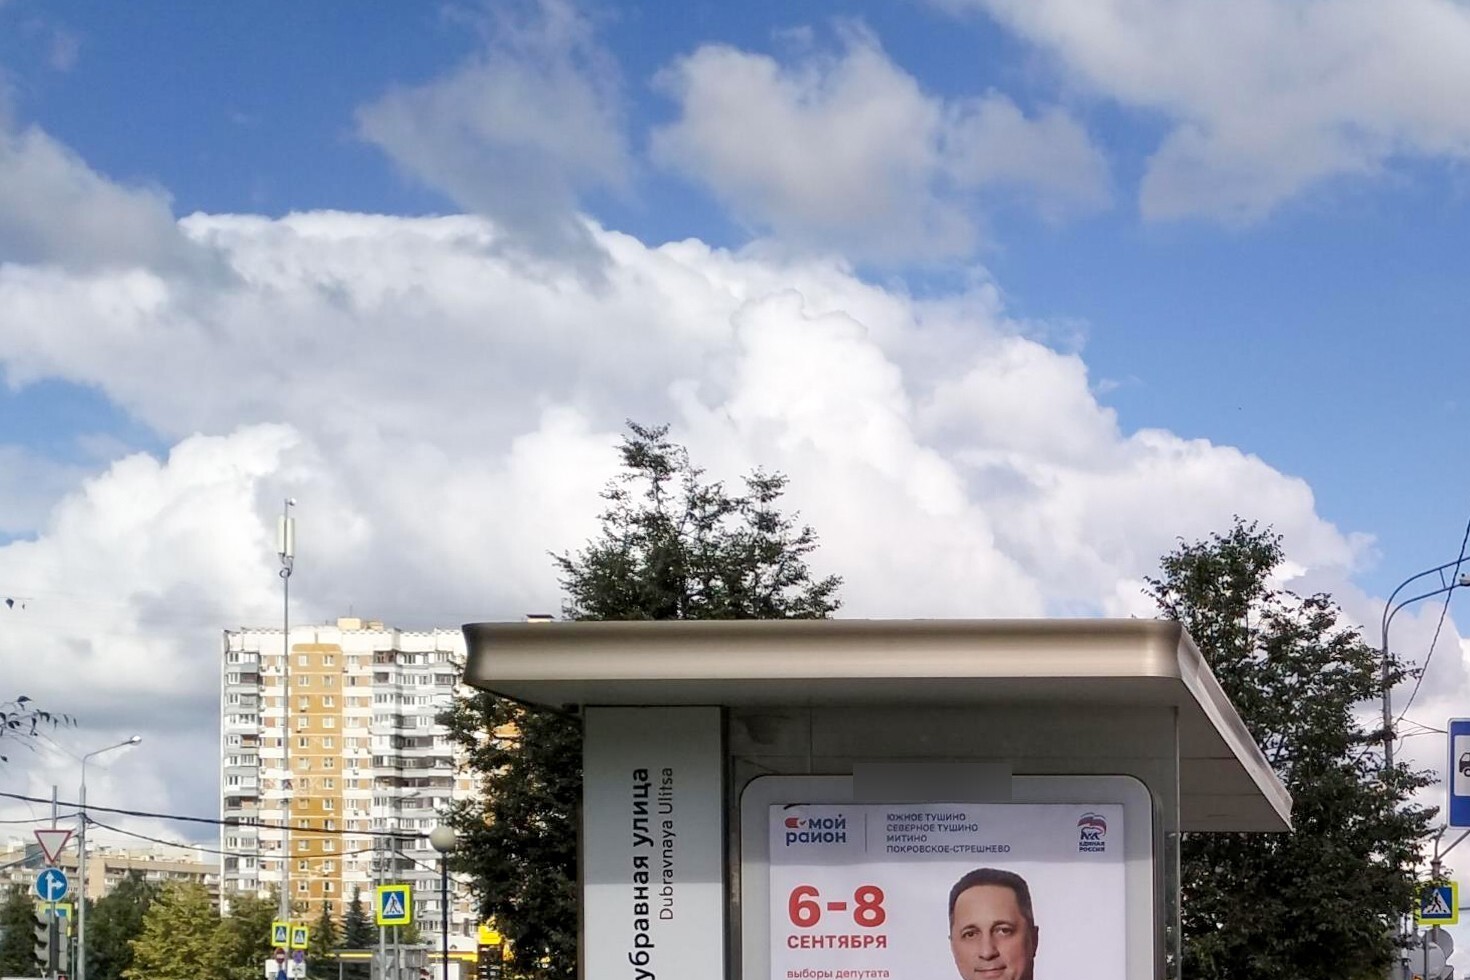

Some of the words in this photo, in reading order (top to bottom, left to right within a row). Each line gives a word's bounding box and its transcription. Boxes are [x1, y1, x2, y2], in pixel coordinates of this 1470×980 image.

[658, 767, 673, 815] Ulitsa
[633, 768, 654, 848] улица
[809, 814, 846, 830] мой
[886, 814, 924, 822] ЮЖНОЕ
[926, 813, 966, 822] ТУШИНО
[886, 824, 936, 832] СЕВЕРНОЕ
[937, 824, 978, 832] ТУШИНО
[886, 834, 928, 842] МИТИНО
[886, 844, 1011, 853] ПОКРОВСКОЕ-СТРЕШНЕВО
[659, 820, 676, 920] Dubravnaya
[787, 935, 887, 949] СЕНТЯБРЯ
[787, 969, 832, 980] выборы
[836, 970, 890, 980] депутата
